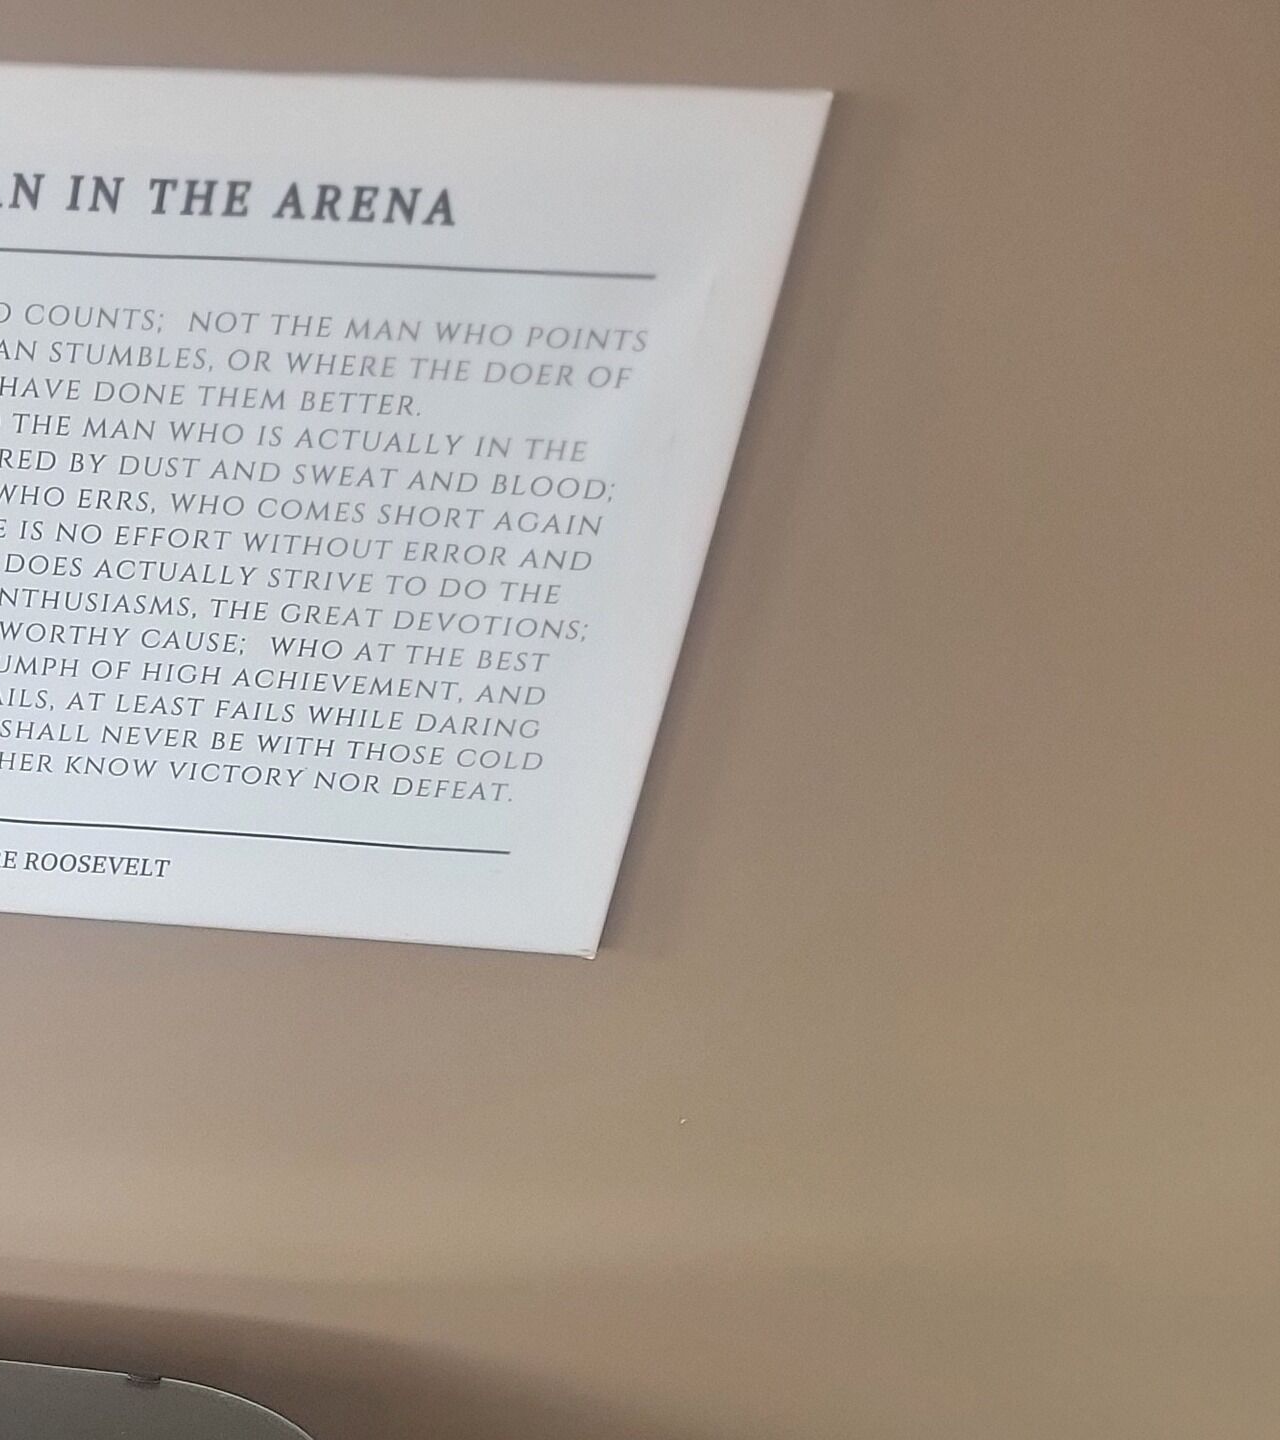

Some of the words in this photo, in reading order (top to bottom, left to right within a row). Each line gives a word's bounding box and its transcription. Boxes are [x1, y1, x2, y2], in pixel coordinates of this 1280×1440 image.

[64, 173, 126, 216] IN
[148, 176, 254, 219] THE
[270, 180, 457, 228] ARENA
[23, 302, 165, 335] COUNTS;
[187, 310, 262, 335] NOT
[270, 312, 334, 339] THE
[343, 317, 423, 343] MAN
[434, 320, 515, 348] WHO
[525, 325, 649, 354] POINTS
[48, 340, 214, 373] STUMBLES,
[226, 347, 271, 373] OR
[286, 350, 398, 379] WHERE
[410, 356, 472, 383] THE
[482, 360, 575, 388] DOER
[586, 364, 634, 391] OF
[93, 380, 186, 406] DONE
[197, 384, 286, 411] THEM
[299, 389, 422, 417] BETTER.
[11, 412, 72, 438] THE
[81, 416, 157, 442] MAN
[169, 420, 245, 446] WHO
[256, 424, 284, 448] IS
[293, 426, 465, 457] ACTUALLY
[474, 435, 513, 459] IN
[524, 437, 589, 463] THE
[68, 451, 108, 475] BY
[118, 454, 202, 479] DUST
[208, 458, 282, 484] AND
[291, 462, 400, 490] SWEAT
[405, 468, 480, 494] AND
[490, 472, 617, 504] BLOOD;
[76, 487, 156, 515] ERRS,
[170, 492, 246, 518] WHO
[256, 496, 367, 525] COMES
[376, 503, 486, 530] SHORT
[492, 510, 604, 537] AGAIN
[18, 519, 45, 542] IS
[54, 521, 103, 545] NO
[113, 524, 233, 551] EFFORT
[243, 531, 394, 561] WITHOUT
[402, 540, 508, 568] ERROR
[517, 548, 593, 572] AND
[3, 552, 84, 579] DOES
[92, 558, 258, 587] ACTUALLY
[266, 567, 375, 594] STRIVE
[385, 573, 428, 598] TO
[438, 577, 488, 601] DO
[499, 580, 562, 606] THE
[209, 597, 270, 622] THE
[279, 602, 384, 629] GREAT
[392, 609, 590, 643] DEVOTIONS;
[140, 627, 247, 656] CAUSE;
[270, 635, 344, 661] WHO
[353, 641, 397, 664] AT
[405, 643, 466, 668] THE
[475, 648, 551, 673] BEST
[90, 658, 132, 681] OF
[141, 661, 222, 686] HIGH
[230, 667, 464, 704] ACHIEVEMENT,
[474, 683, 547, 707] AND
[65, 691, 107, 712] AT
[115, 693, 206, 718] LEAST
[214, 698, 296, 724] FAILS
[308, 704, 405, 731] WHILE
[414, 712, 541, 740] DARING
[100, 724, 199, 750] NEVER
[209, 730, 245, 753] BE
[257, 733, 336, 759] WITH
[346, 739, 446, 767] THOSE
[455, 747, 545, 772] COLD
[63, 754, 159, 779] KNOW
[168, 760, 305, 788] VICTORY
[312, 770, 380, 795] NOR
[391, 776, 514, 803] DEFEAT.
[22, 851, 172, 879] ROOSEVELT
